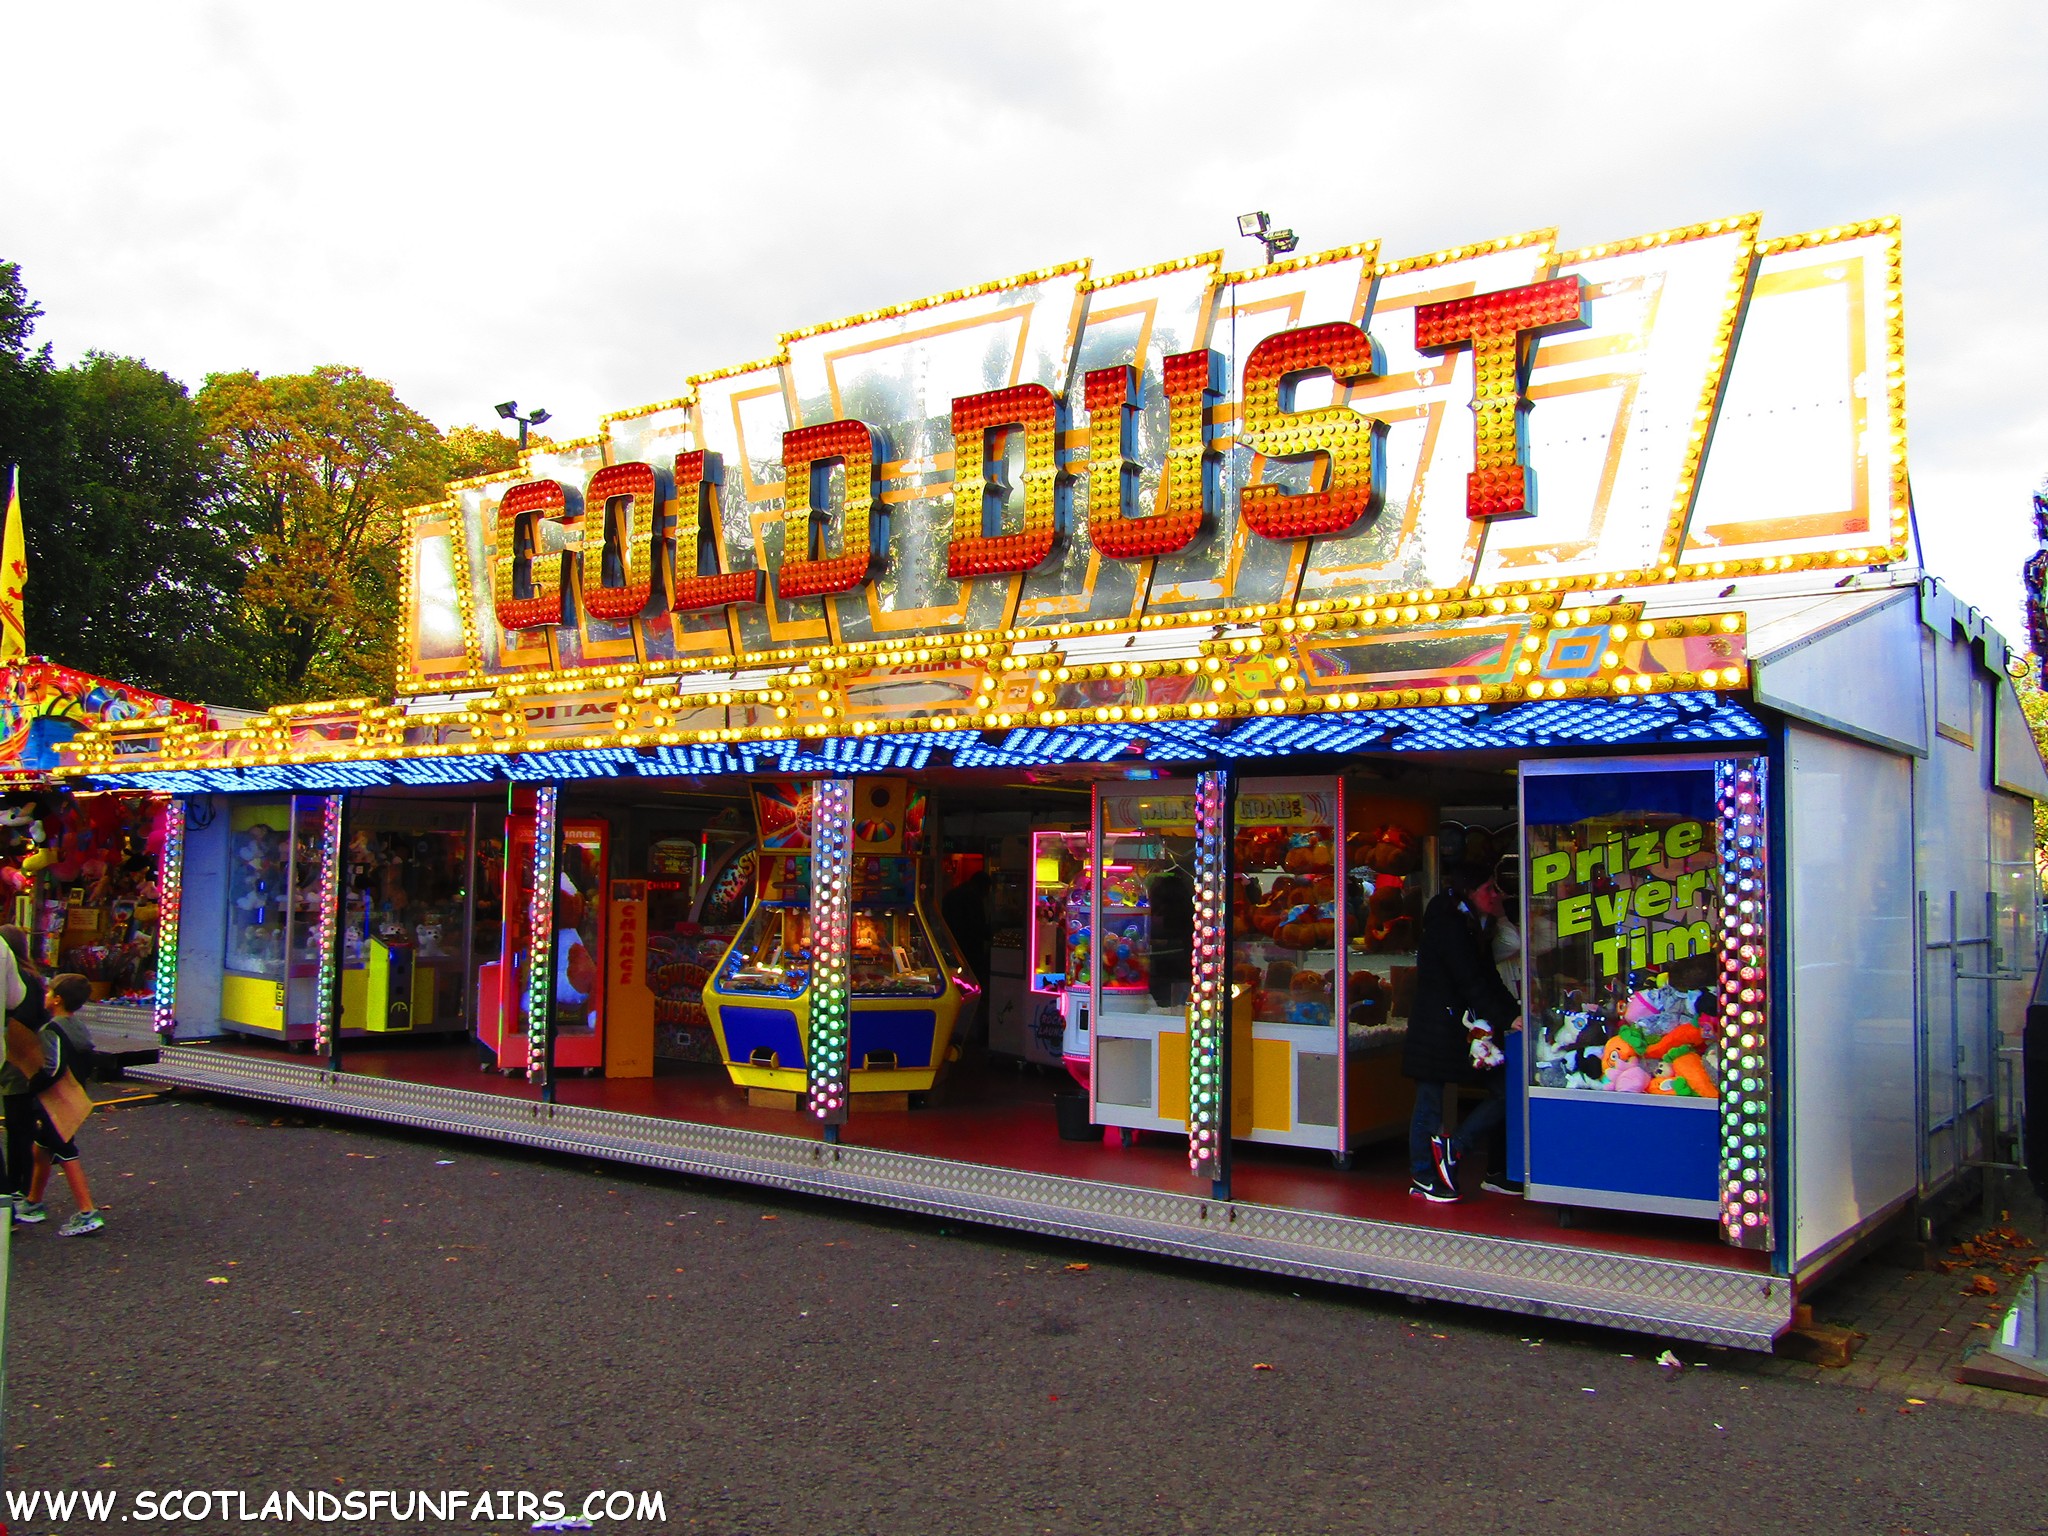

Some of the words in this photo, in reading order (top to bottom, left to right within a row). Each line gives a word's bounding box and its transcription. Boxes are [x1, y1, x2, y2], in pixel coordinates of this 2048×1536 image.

[495, 418, 891, 631] GOLD
[947, 274, 1590, 580] DUST
[564, 830, 595, 839] INNER
[1532, 821, 1703, 895] Prize
[619, 905, 637, 985] CHANGE
[1593, 920, 1712, 977] Tim
